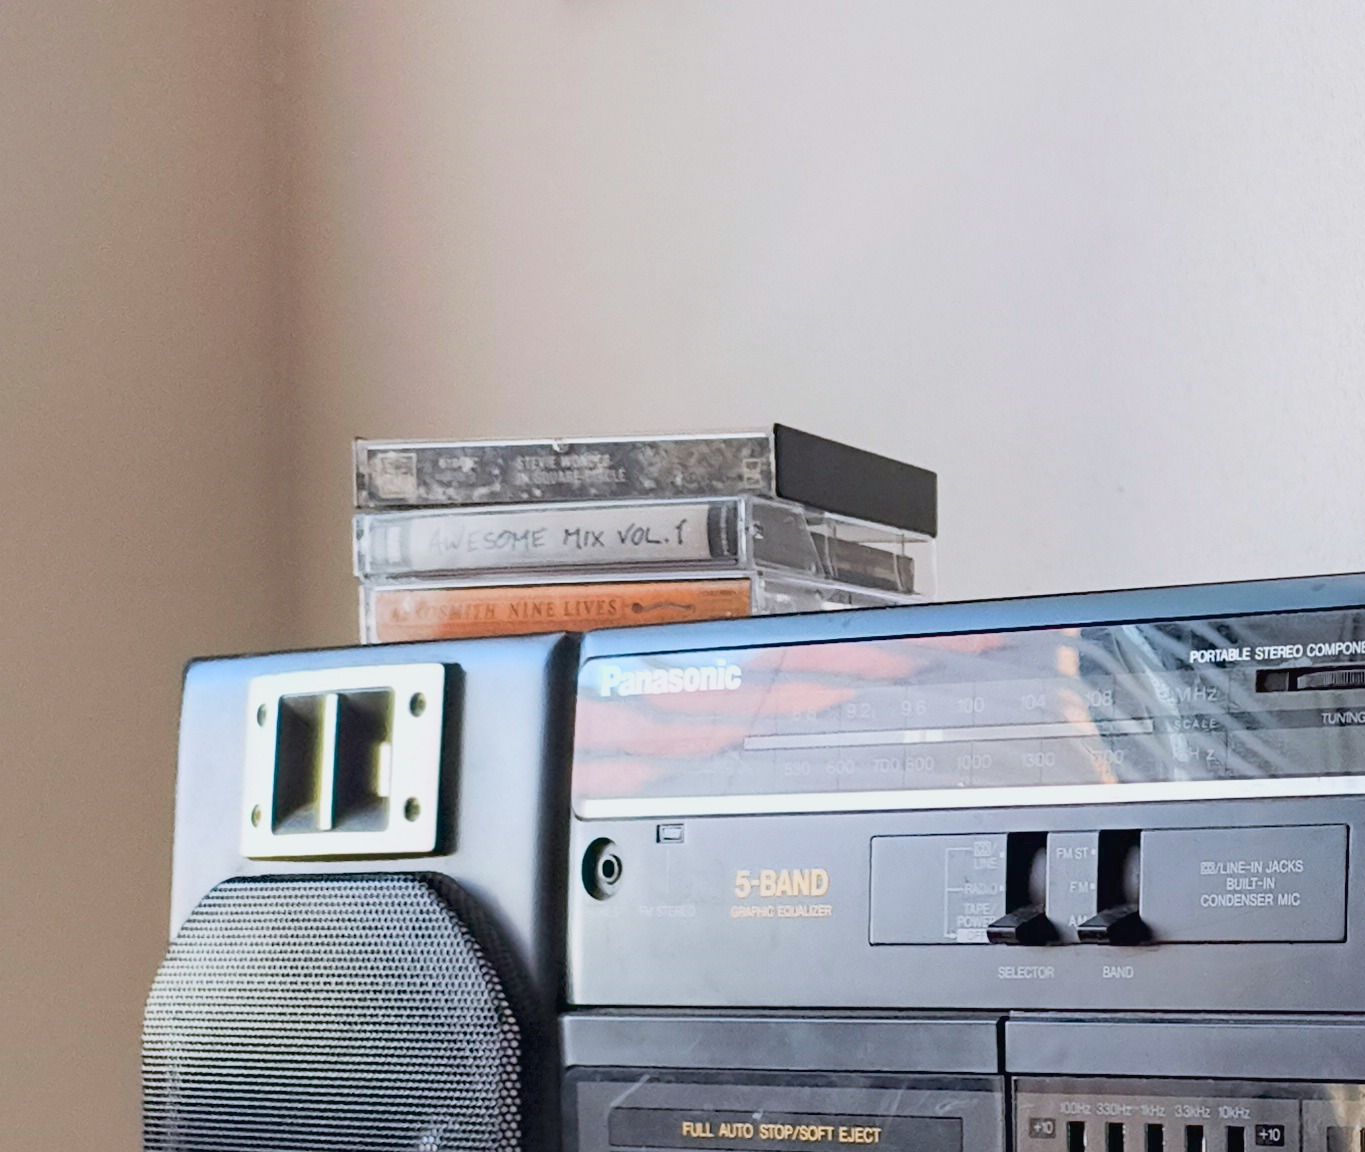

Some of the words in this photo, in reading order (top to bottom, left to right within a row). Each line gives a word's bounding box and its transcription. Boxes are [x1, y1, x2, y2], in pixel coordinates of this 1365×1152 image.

[429, 526, 548, 553] AWESOME
[562, 527, 605, 549] MIX
[508, 602, 554, 619] NINE
[563, 599, 617, 617] LIVES
[1189, 647, 1251, 664] PORTABLE
[1255, 644, 1303, 660] STEREO
[600, 659, 743, 697] Panasonic
[1174, 719, 1218, 729] SCALE
[1266, 859, 1304, 873] JACKS
[735, 868, 830, 899] 5-BAND
[1069, 881, 1088, 893] FM
[1226, 877, 1275, 890] BUILT-IN
[1200, 893, 1274, 907] CONDENSER
[1278, 892, 1301, 906] MIC
[730, 905, 774, 919] GRAPHIC
[777, 904, 832, 918] EQUALIZER
[997, 965, 1055, 979] SELECTOR
[1103, 965, 1134, 979] BAND
[1060, 1103, 1091, 1115] 100Hz
[1097, 1103, 1132, 1116] 330Hz
[1218, 1106, 1251, 1120] 10kHz
[682, 1120, 715, 1138] FULL
[719, 1122, 754, 1140] AUTO
[759, 1123, 835, 1142] STOP/SOFT
[838, 1126, 881, 1144] EJECT
[1258, 1127, 1280, 1141] +10
